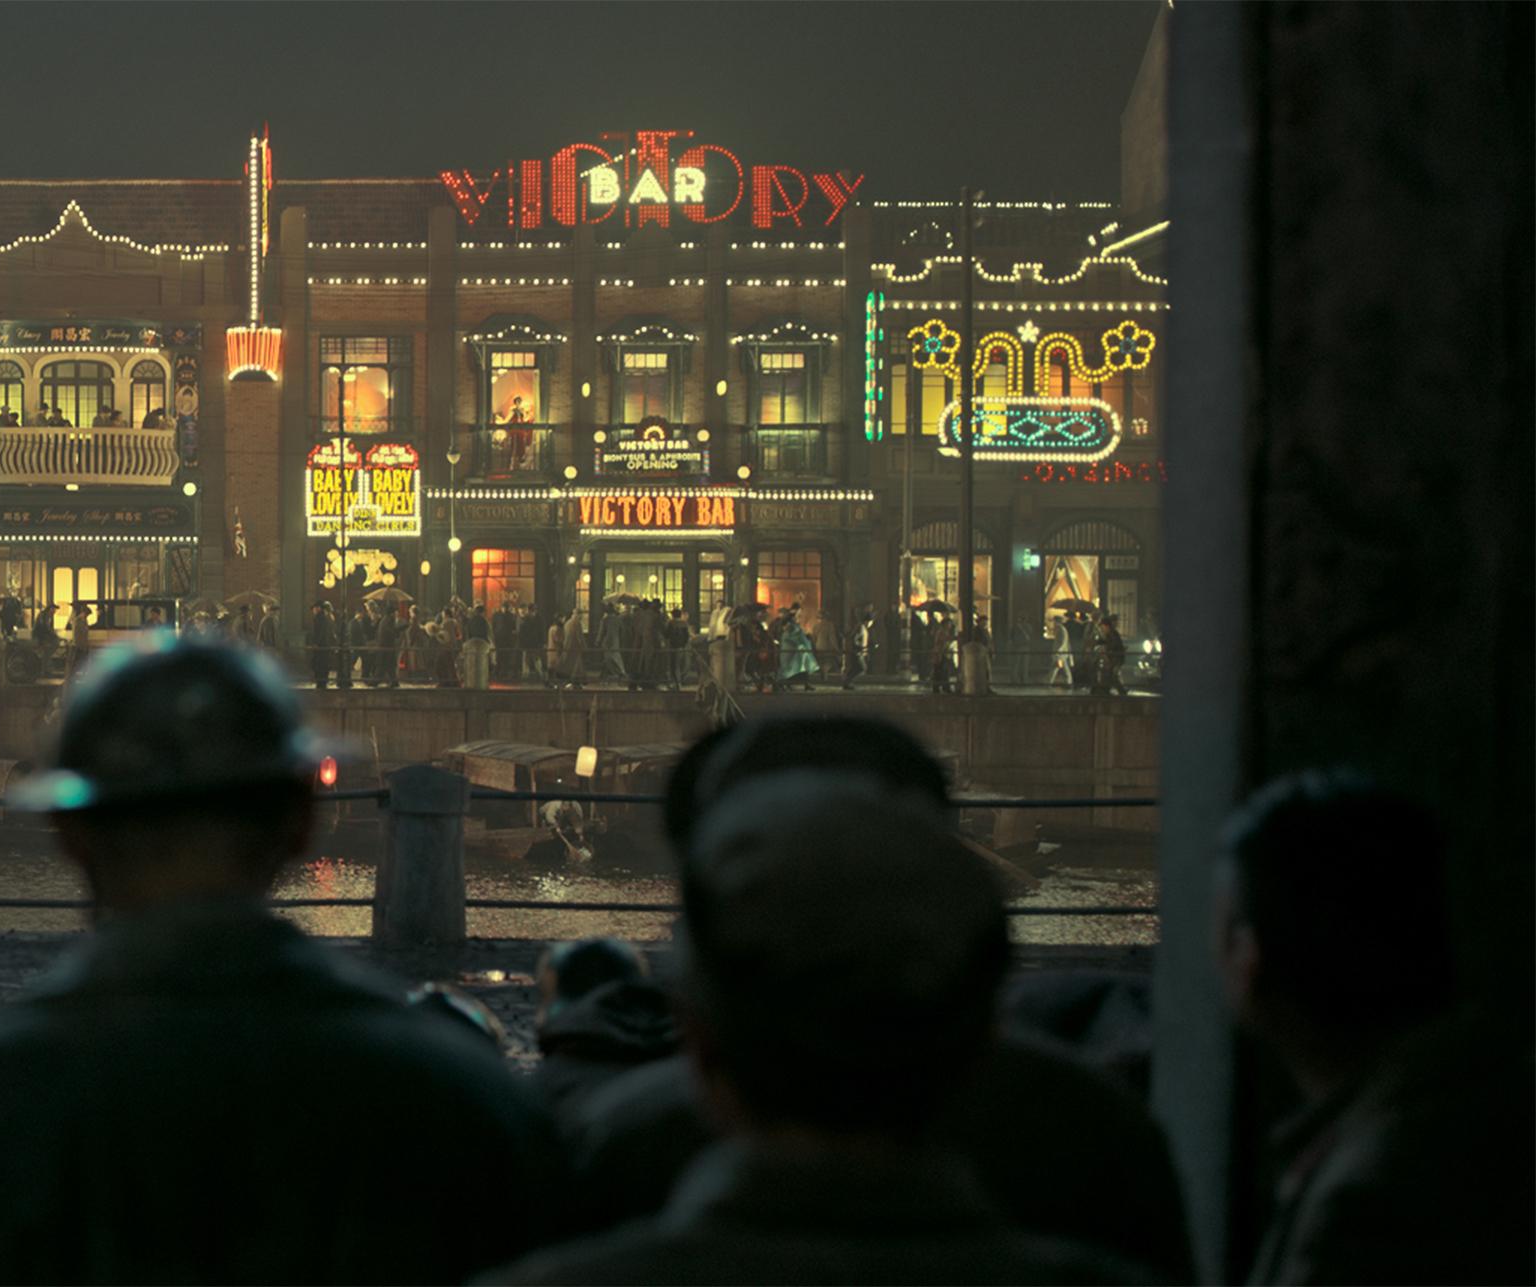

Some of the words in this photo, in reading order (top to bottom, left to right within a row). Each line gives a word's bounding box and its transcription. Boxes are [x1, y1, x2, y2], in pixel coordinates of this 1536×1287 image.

[589, 167, 707, 204] BAR
[626, 460, 678, 470] OPENING
[372, 469, 413, 492] BABY
[579, 496, 686, 526] VICTORY
[696, 496, 735, 526] BAR
[315, 521, 370, 532] DANING
